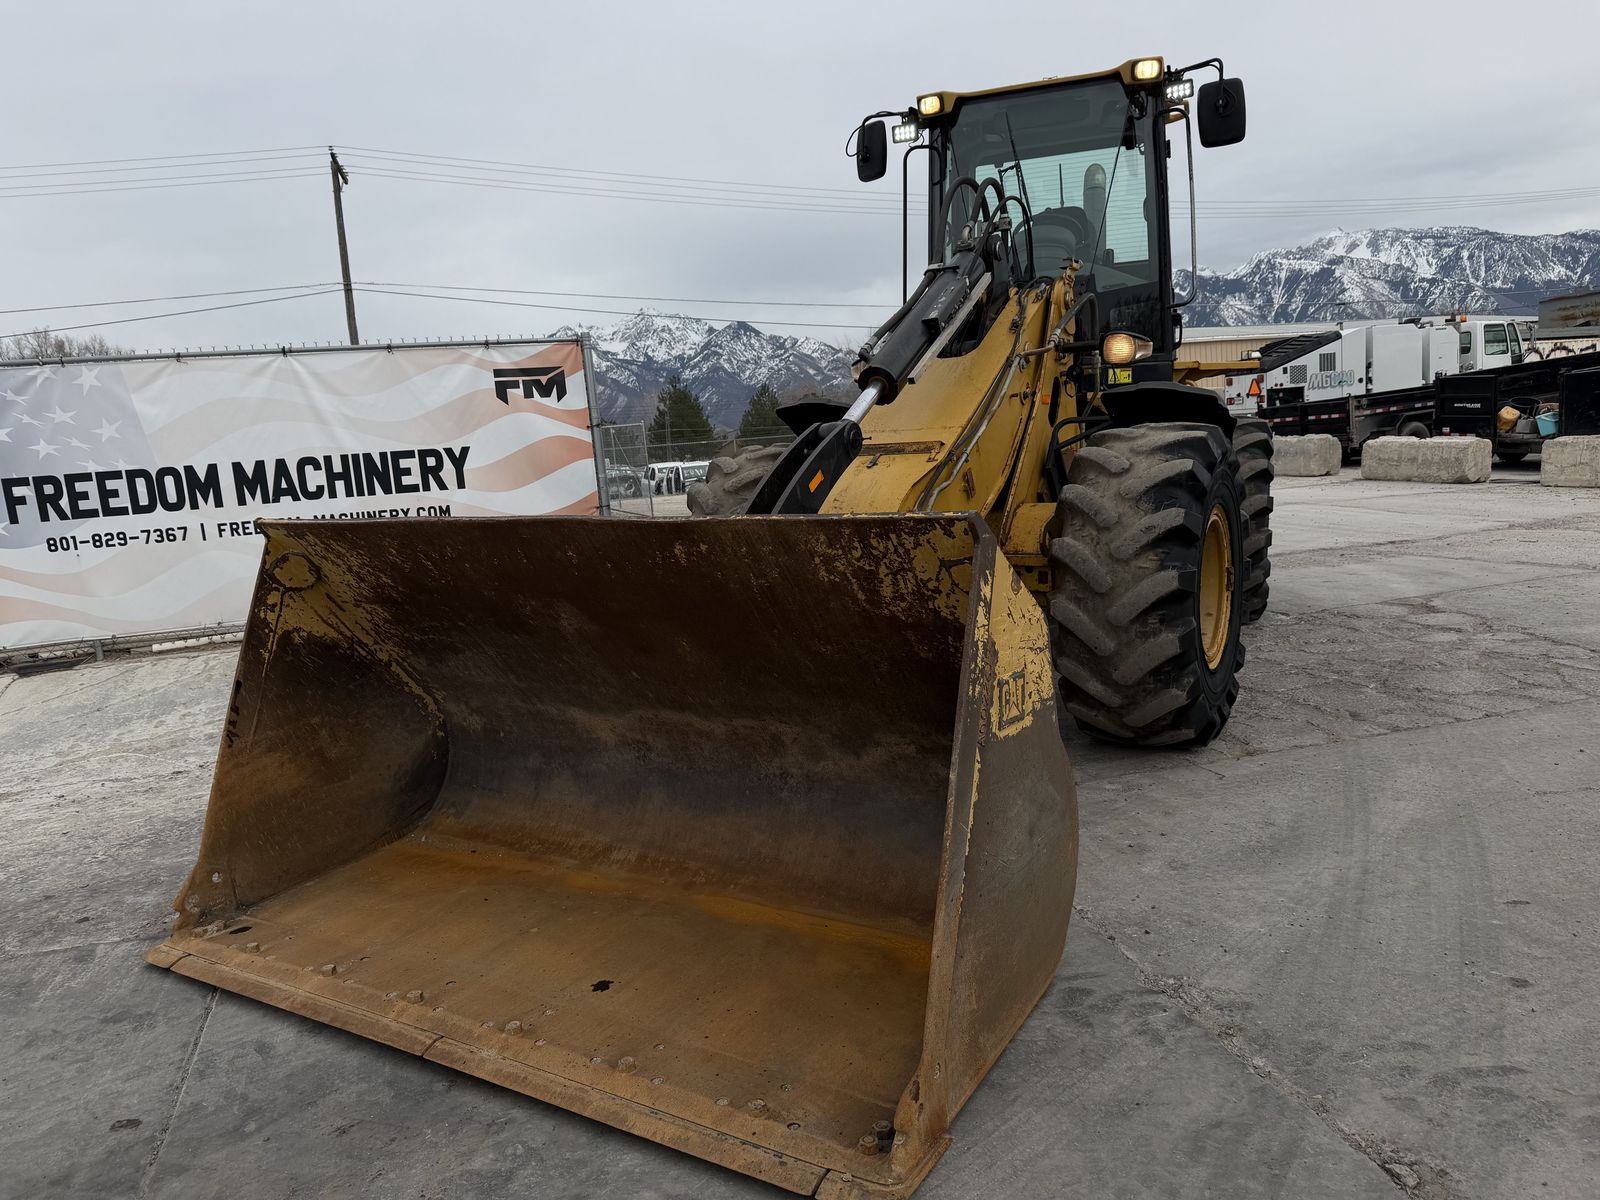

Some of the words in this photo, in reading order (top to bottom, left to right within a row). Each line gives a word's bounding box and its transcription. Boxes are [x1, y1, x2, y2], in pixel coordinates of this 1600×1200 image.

[493, 366, 567, 406] FM
[1, 463, 224, 525] FREEDOM
[231, 446, 471, 506] MACHINERY
[46, 525, 188, 553] 801-829-7367
